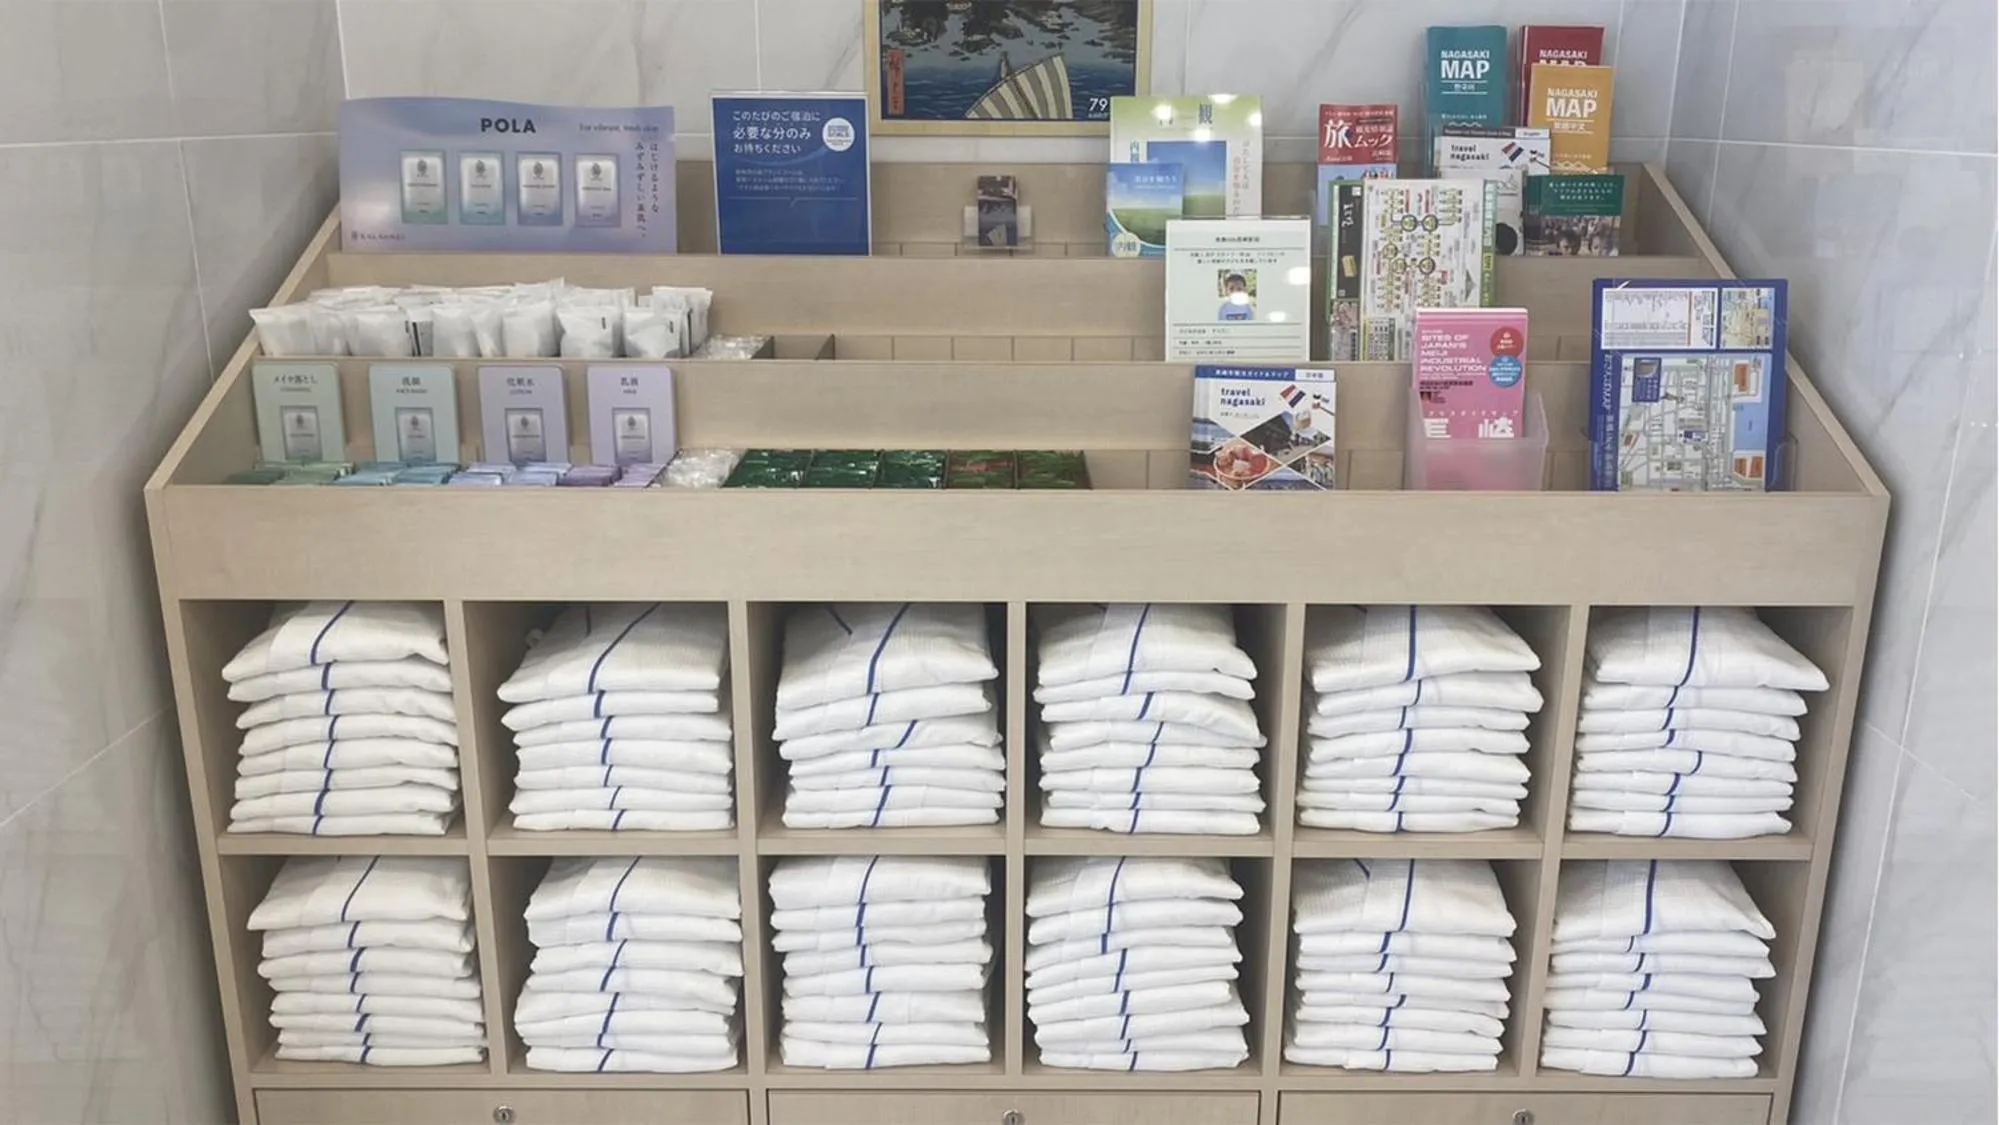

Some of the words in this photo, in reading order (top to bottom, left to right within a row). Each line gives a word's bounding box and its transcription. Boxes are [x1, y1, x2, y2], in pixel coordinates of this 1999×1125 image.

[1440, 50, 1490, 59] NAGASAKI
[1539, 50, 1588, 59] NAGASAKI
[1440, 61, 1490, 79] MAP
[1547, 88, 1598, 98] NAGASAKI
[1088, 98, 1108, 112] 79
[1546, 99, 1597, 118] MAP
[732, 111, 821, 122] このたびのご宿泊に
[480, 118, 536, 134] POLA
[733, 126, 811, 140] 必要な分のみ
[1354, 134, 1393, 148] ムック
[734, 143, 801, 154] お持ちください
[1450, 144, 1477, 153] travel
[1450, 153, 1489, 162] nagasaki
[273, 375, 318, 385] メイク落とし
[402, 377, 421, 386] 洗顔
[506, 377, 535, 387] 化粧水
[620, 377, 639, 387] 乳液
[1221, 388, 1251, 396] travel
[1220, 397, 1265, 407] nagasaki
